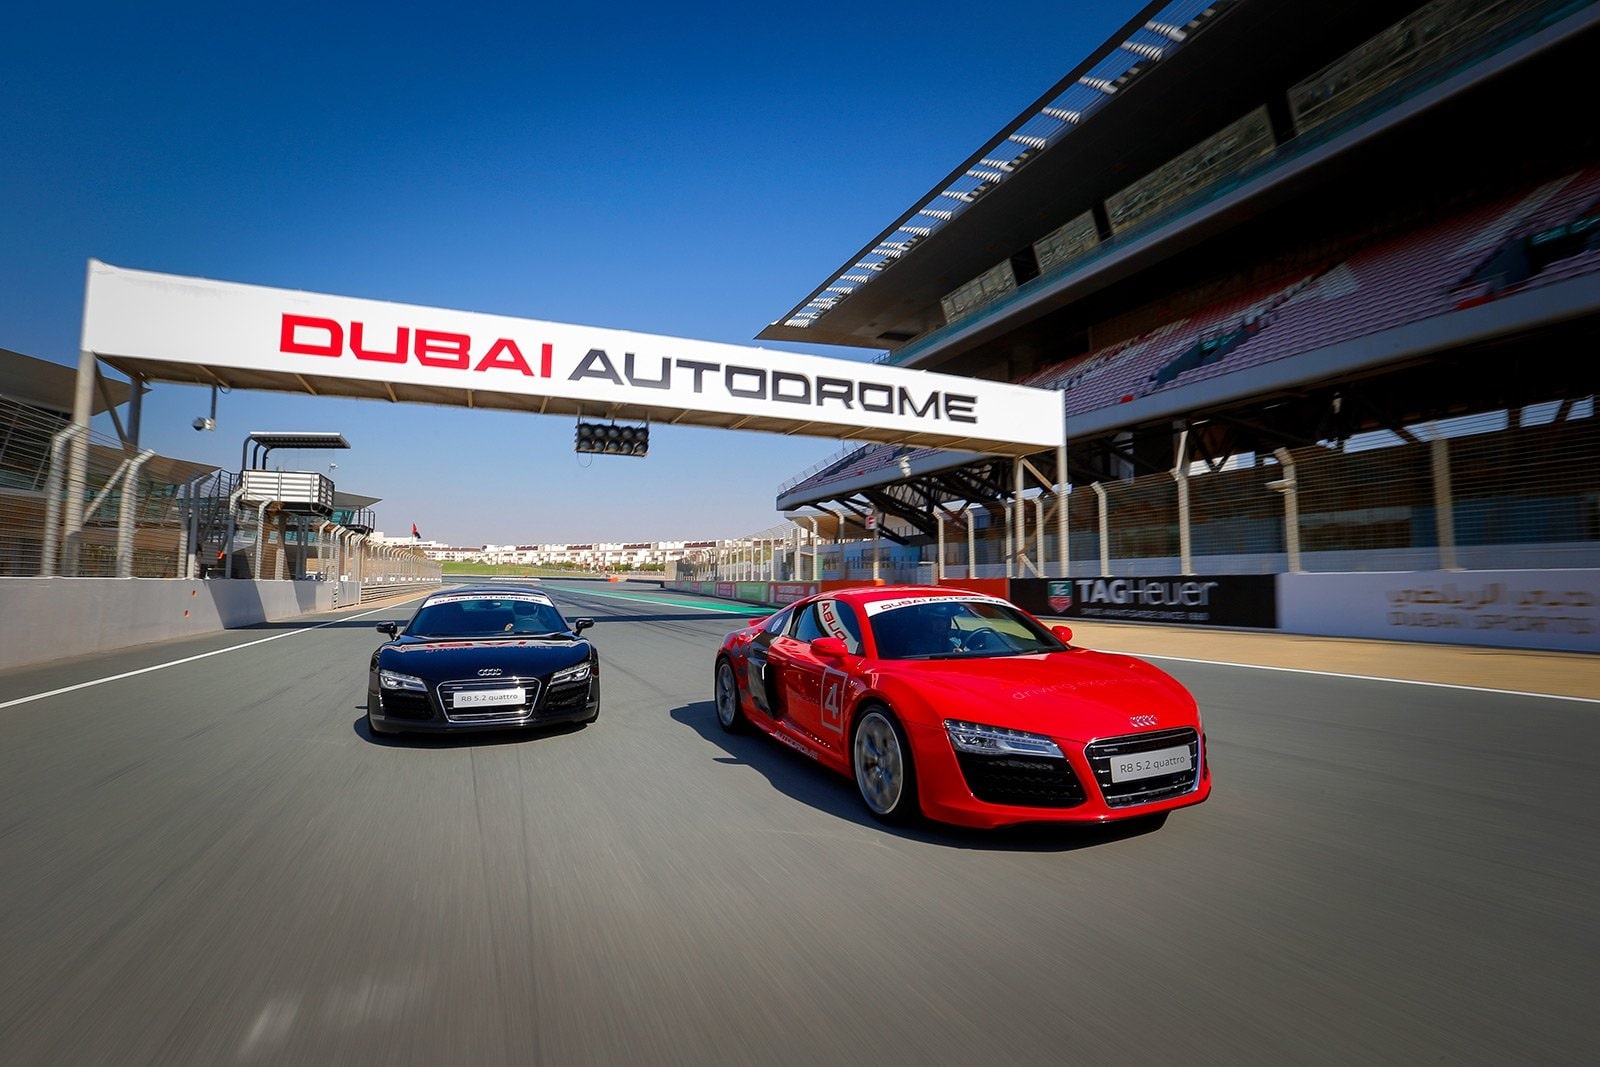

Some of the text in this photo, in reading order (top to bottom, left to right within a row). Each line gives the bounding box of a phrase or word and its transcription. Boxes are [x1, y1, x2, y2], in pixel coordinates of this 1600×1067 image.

[279, 312, 979, 424] DUBAI AUTODROME
[880, 598, 927, 610] DUBAI
[474, 694, 487, 702] 5.2
[488, 694, 518, 703] quattro
[825, 683, 839, 720] 4
[1120, 755, 1185, 774] R8 5.2 quattro
